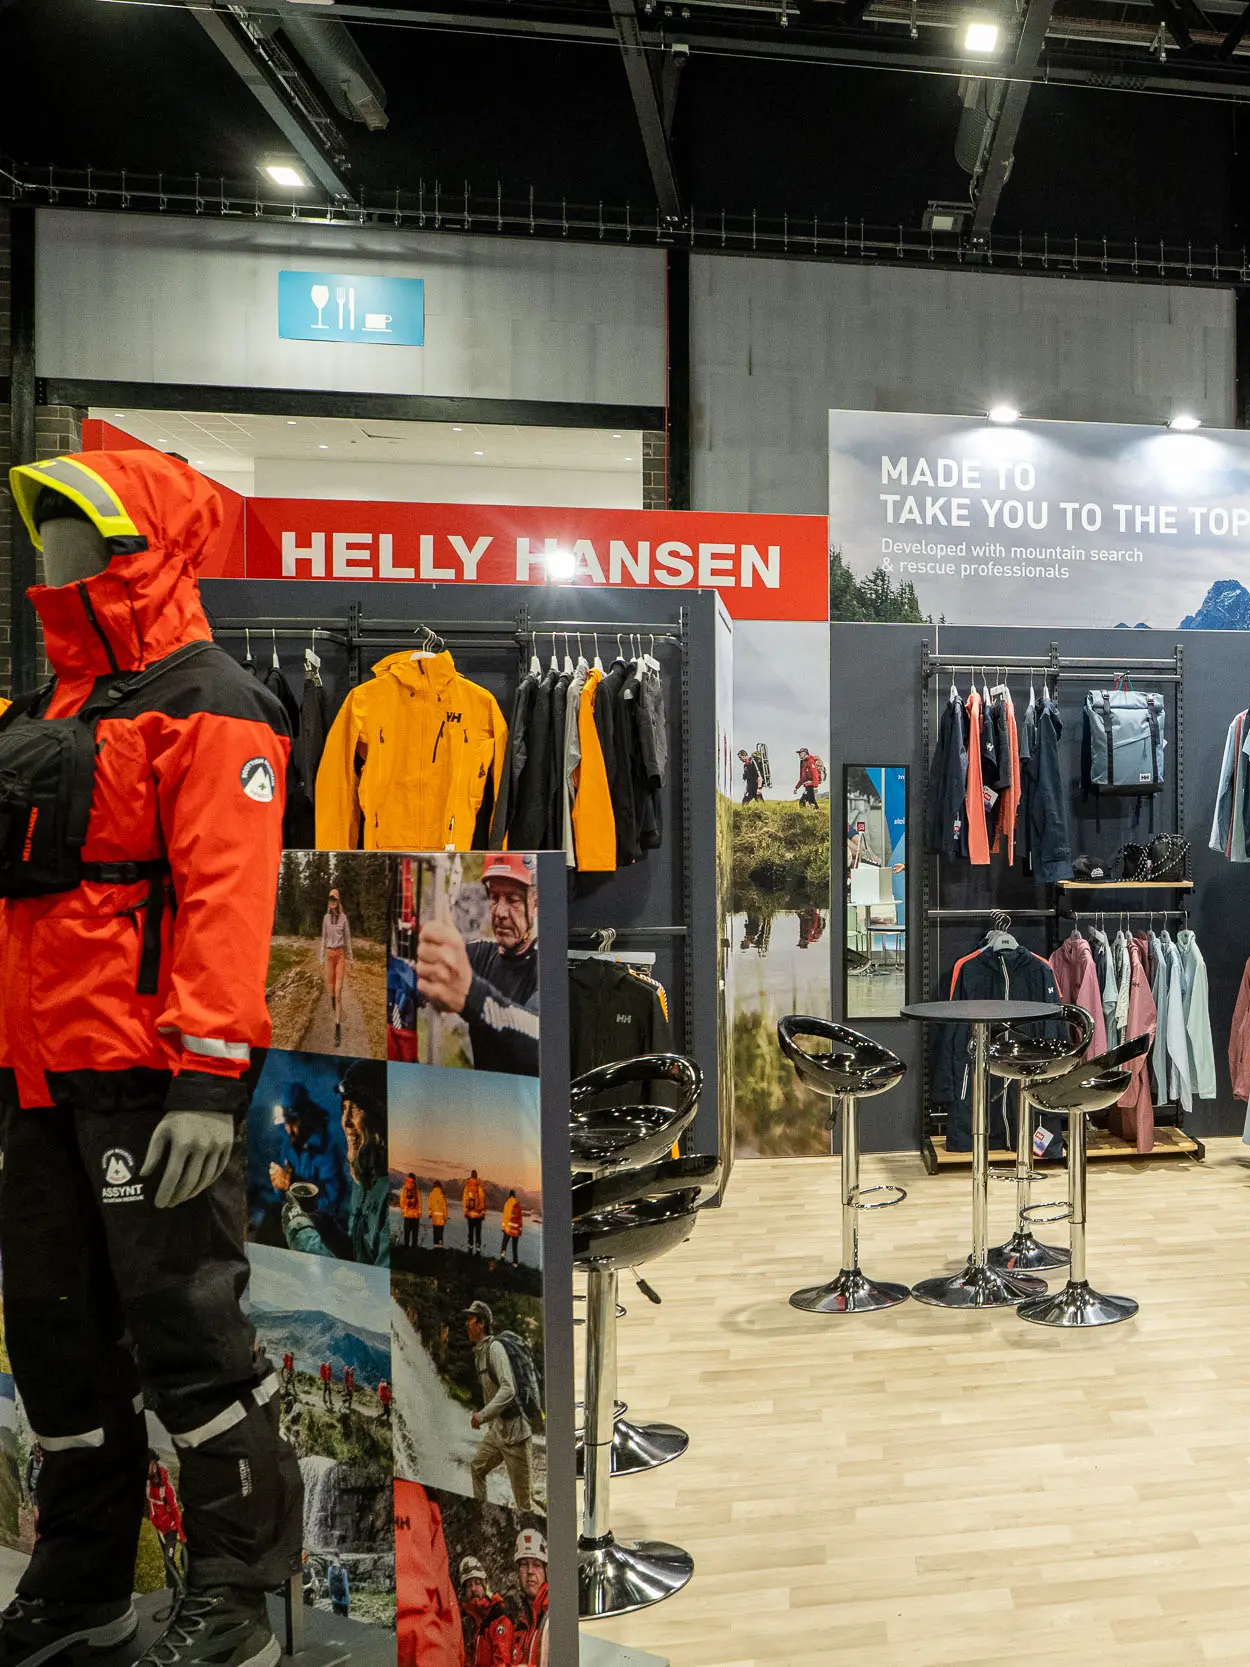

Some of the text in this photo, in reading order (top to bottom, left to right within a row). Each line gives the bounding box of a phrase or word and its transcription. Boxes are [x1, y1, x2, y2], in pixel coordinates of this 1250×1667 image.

[881, 456, 1036, 491] MADE TO
[880, 493, 970, 526] TAKE
[981, 498, 1048, 530] YOU
[1060, 502, 1102, 532] TO
[1113, 503, 1178, 534] THE
[281, 531, 780, 588] HELLY HANSEN
[881, 537, 1143, 562] Developed with mountain search
[882, 556, 1070, 578] & rescue professionals
[446, 711, 462, 723] HH
[616, 1013, 632, 1024] HH
[102, 1184, 144, 1197] ASSYNT
